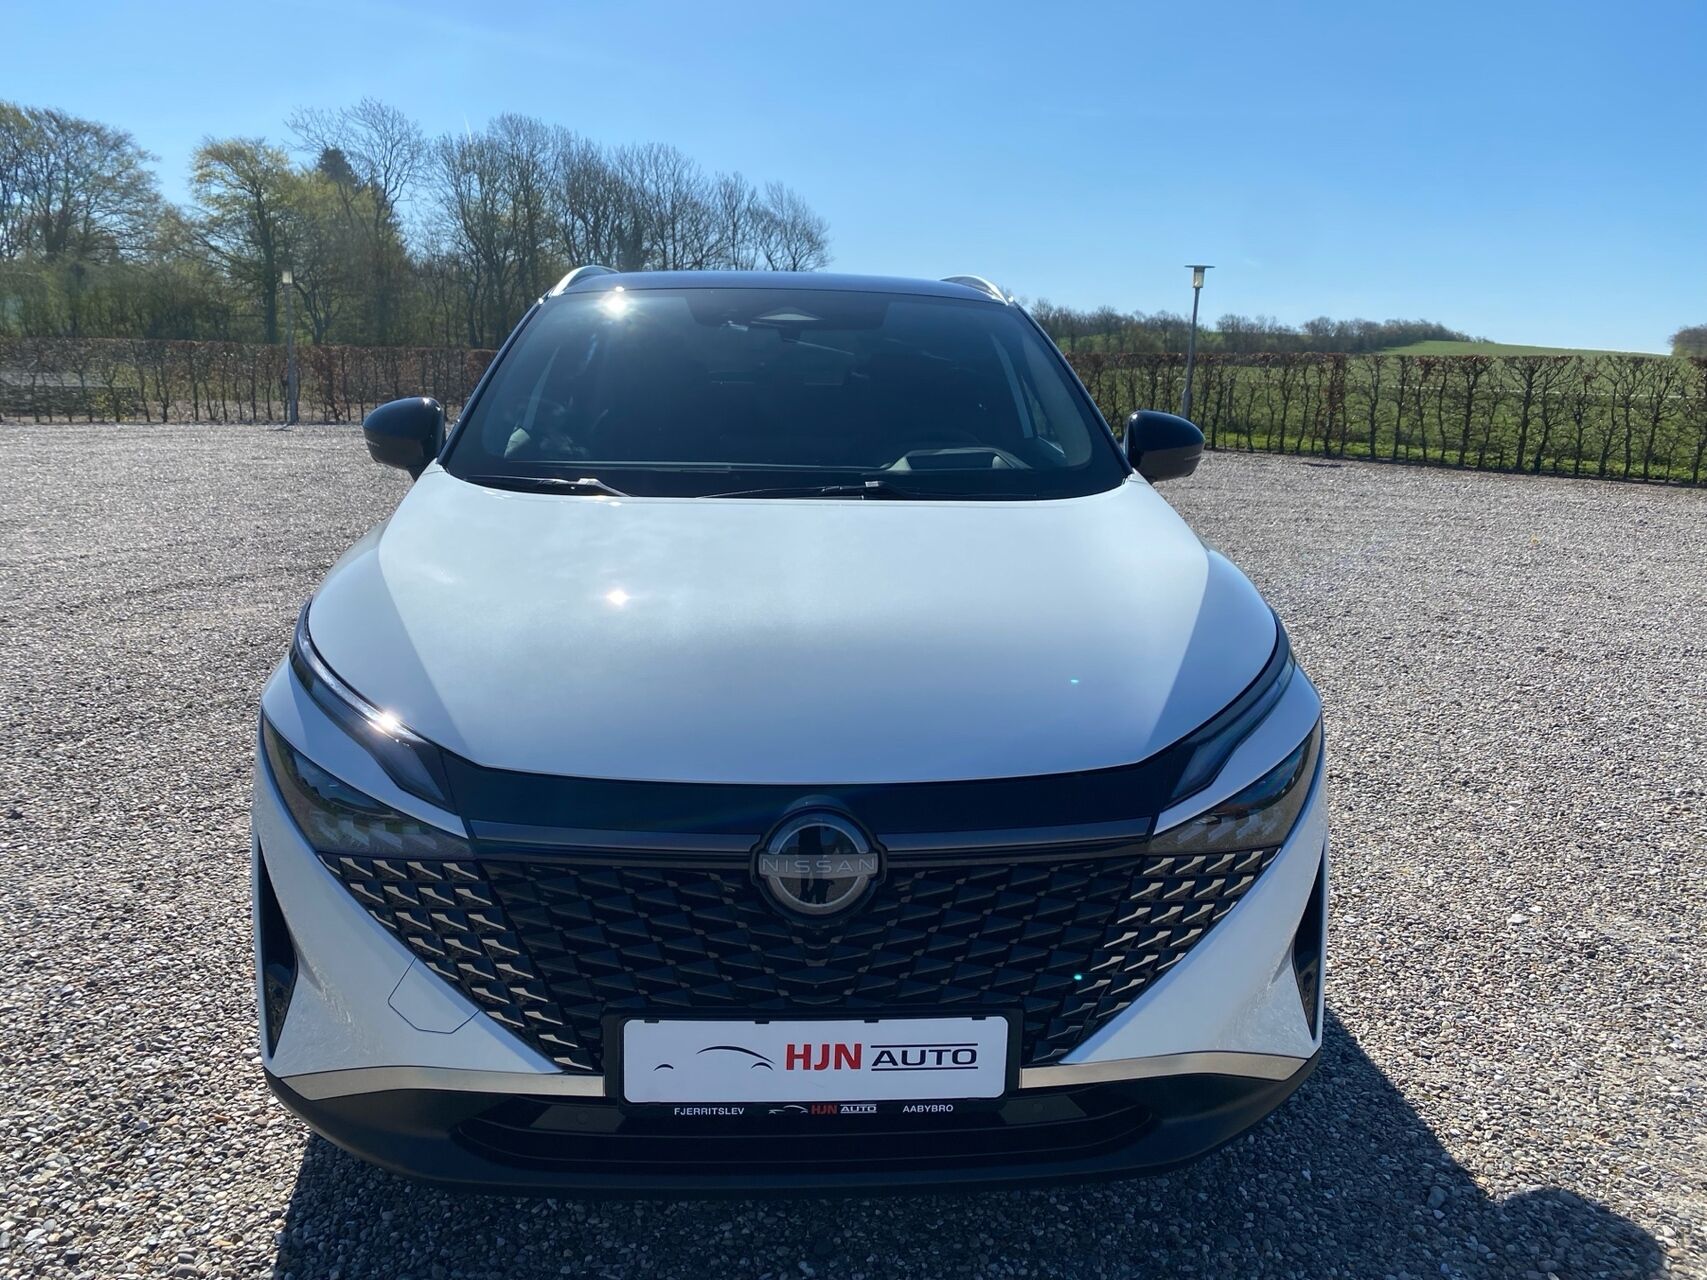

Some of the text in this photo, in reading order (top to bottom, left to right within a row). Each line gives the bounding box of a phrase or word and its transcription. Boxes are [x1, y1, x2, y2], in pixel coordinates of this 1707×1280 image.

[762, 858, 875, 874] NISSAN
[786, 1043, 977, 1070] HJN AUTO
[674, 1107, 745, 1116] FJERRITSLEV
[811, 1104, 877, 1115] HJN AUTO
[902, 1104, 954, 1113] AABYBRO
